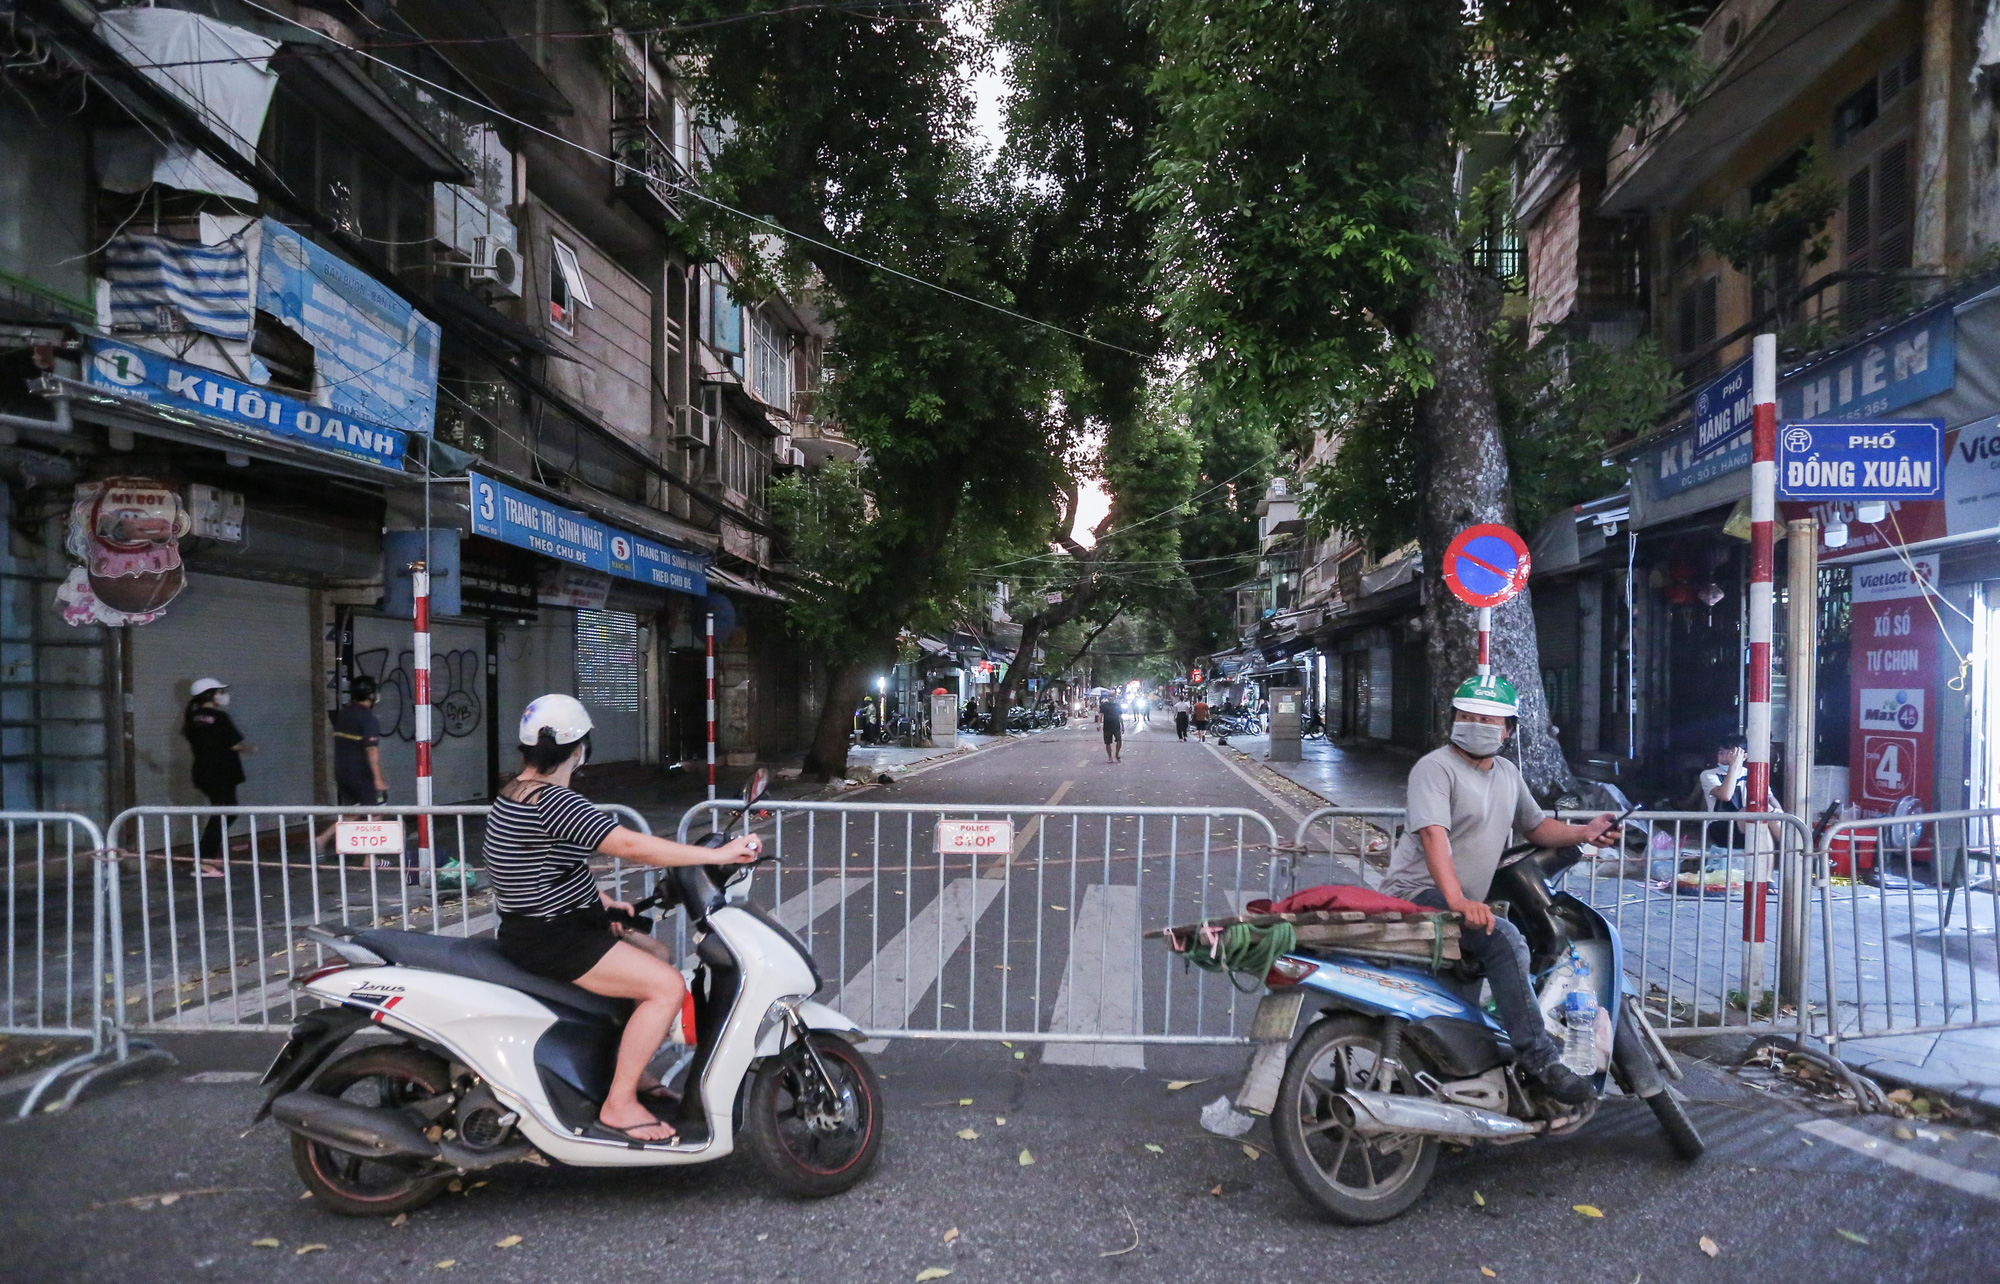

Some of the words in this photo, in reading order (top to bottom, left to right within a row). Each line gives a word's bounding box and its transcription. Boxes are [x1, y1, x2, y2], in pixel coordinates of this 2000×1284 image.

[111, 355, 129, 380] 1
[1723, 370, 1743, 399] PHỐ
[167, 369, 281, 425] KHÔI
[296, 410, 393, 455] OANH
[1864, 398, 1888, 417] 365
[1699, 408, 1731, 448] HÀNG
[1849, 430, 1896, 449] PHỐ
[1721, 453, 1748, 472] HÀNG
[1788, 452, 1855, 487] ĐỒNG
[1862, 456, 1931, 487] XUÂN
[111, 493, 133, 505] MY
[136, 494, 166, 506] BOY
[480, 482, 494, 520] 3
[504, 496, 539, 531] TRANG
[541, 509, 556, 537] TRÍ
[559, 516, 579, 545] SINH
[582, 525, 603, 555] NHẬT
[529, 535, 553, 553] THEO
[617, 540, 625, 558] 5
[636, 543, 659, 562] TRANG
[652, 568, 668, 584] THEO
[1860, 570, 1908, 589] Vietlott
[1873, 607, 1891, 638] XỔ
[1893, 606, 1911, 636] SỐ
[1867, 649, 1882, 675] TỰ
[1884, 649, 1919, 676] CHỌN
[1475, 688, 1497, 698] Grab
[1865, 708, 1897, 721] Max
[1875, 744, 1902, 790] 4
[960, 824, 990, 832] POLICE
[350, 835, 388, 847] STOP
[351, 980, 406, 993] Janus
